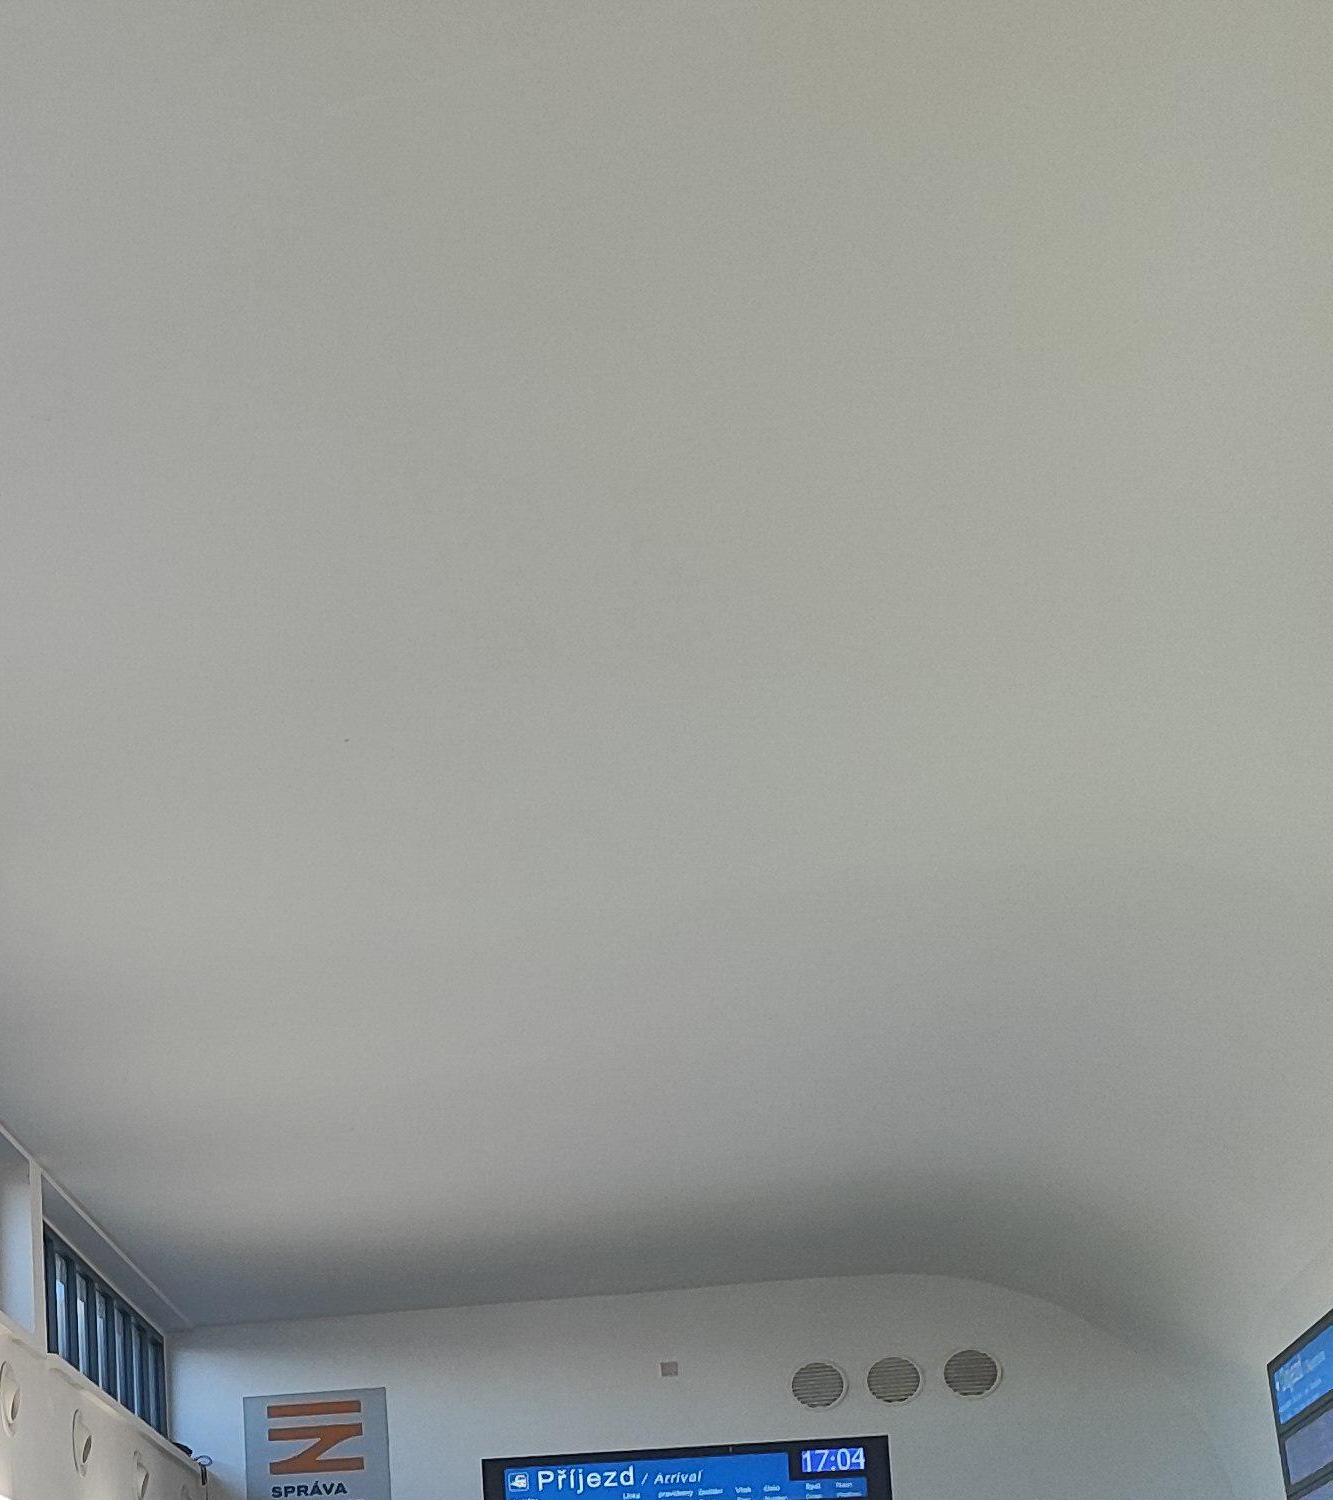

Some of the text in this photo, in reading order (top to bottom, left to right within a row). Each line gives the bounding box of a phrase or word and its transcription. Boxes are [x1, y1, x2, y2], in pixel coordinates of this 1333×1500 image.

[802, 1447, 865, 1472] 17:04
[271, 1480, 347, 1498] SPRÁVA
[538, 1465, 634, 1494] Příjezd
[654, 1470, 703, 1485] Arrival
